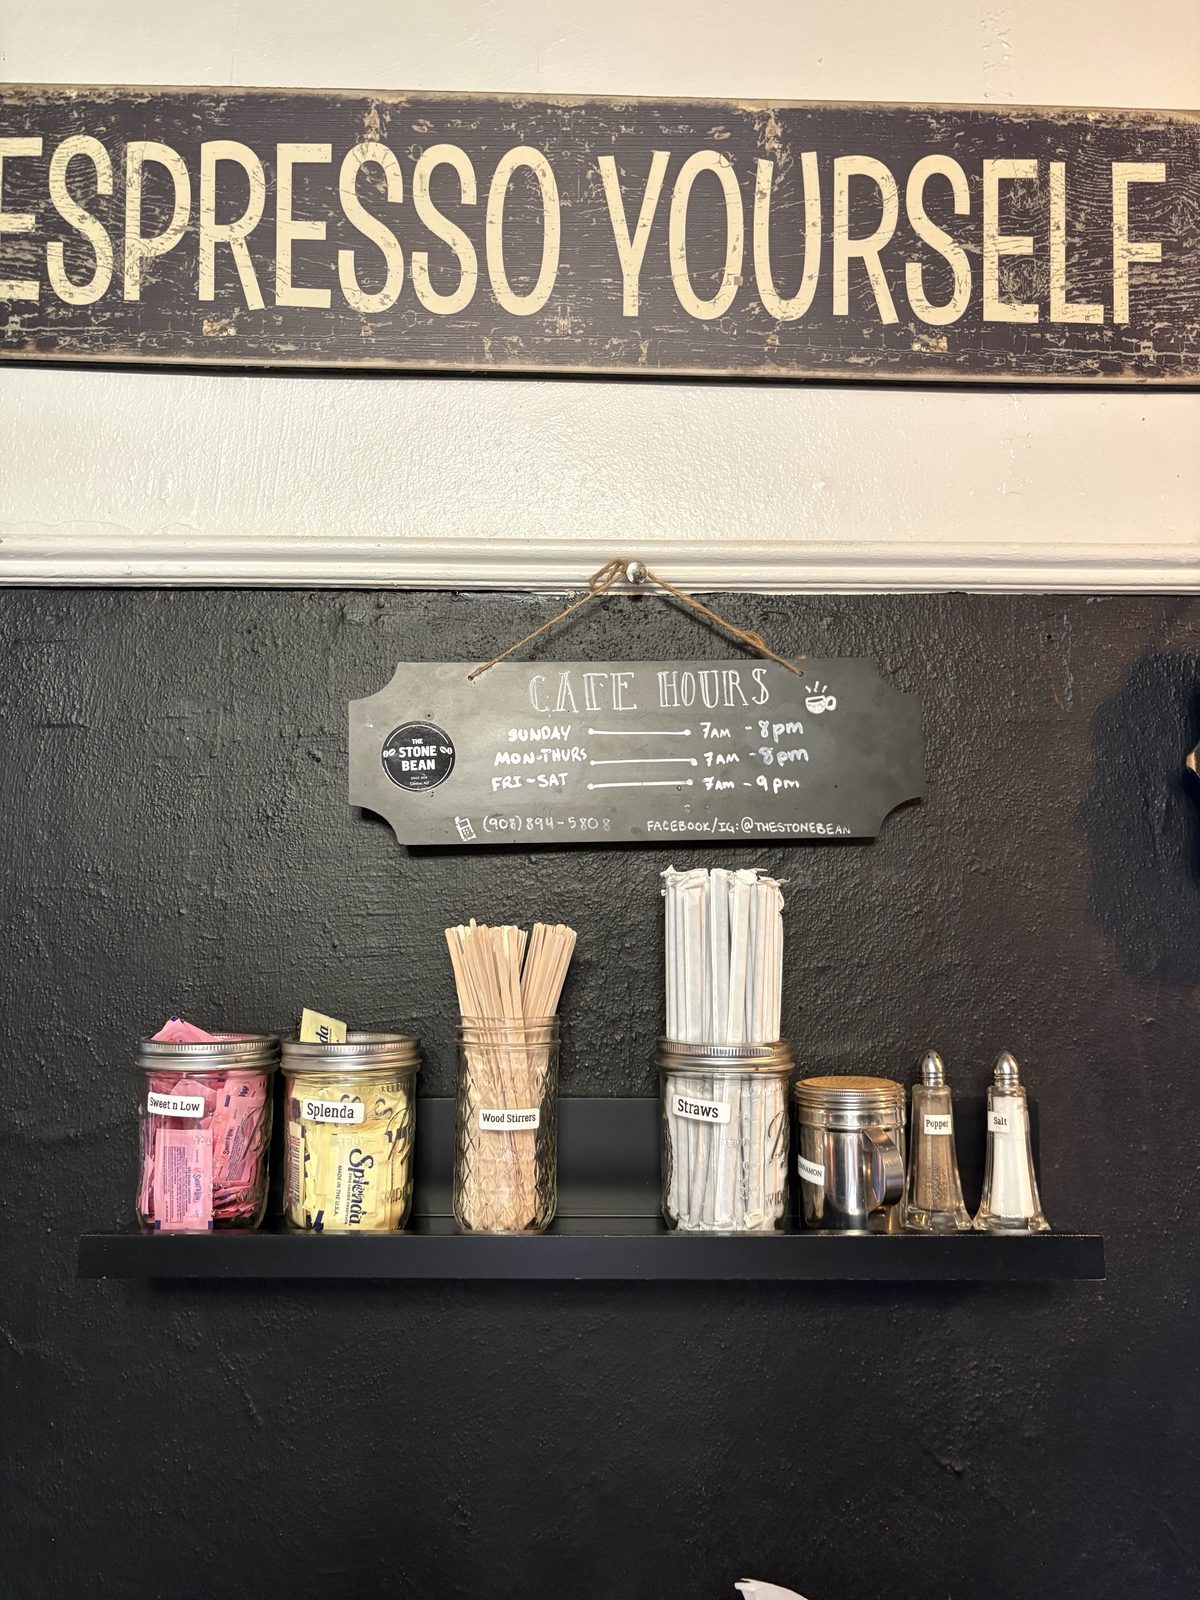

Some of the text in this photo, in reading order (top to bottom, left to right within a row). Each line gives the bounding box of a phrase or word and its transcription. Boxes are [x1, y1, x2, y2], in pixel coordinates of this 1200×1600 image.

[0, 134, 1167, 326] ESPRESSO YOURSELF
[529, 668, 769, 713] CAFE HOURS
[507, 725, 571, 742] SUNDAY
[398, 745, 438, 758] STONE
[494, 746, 587, 766] MON-THURS
[401, 758, 436, 772] BEAN
[149, 1097, 200, 1112] Sweet n Low
[306, 1102, 355, 1119] Splenda
[677, 1098, 719, 1119] Straws
[482, 1113, 536, 1123] Wood Stirrers
[993, 1116, 1007, 1126] Salt
[348, 1148, 374, 1226] Splenda
